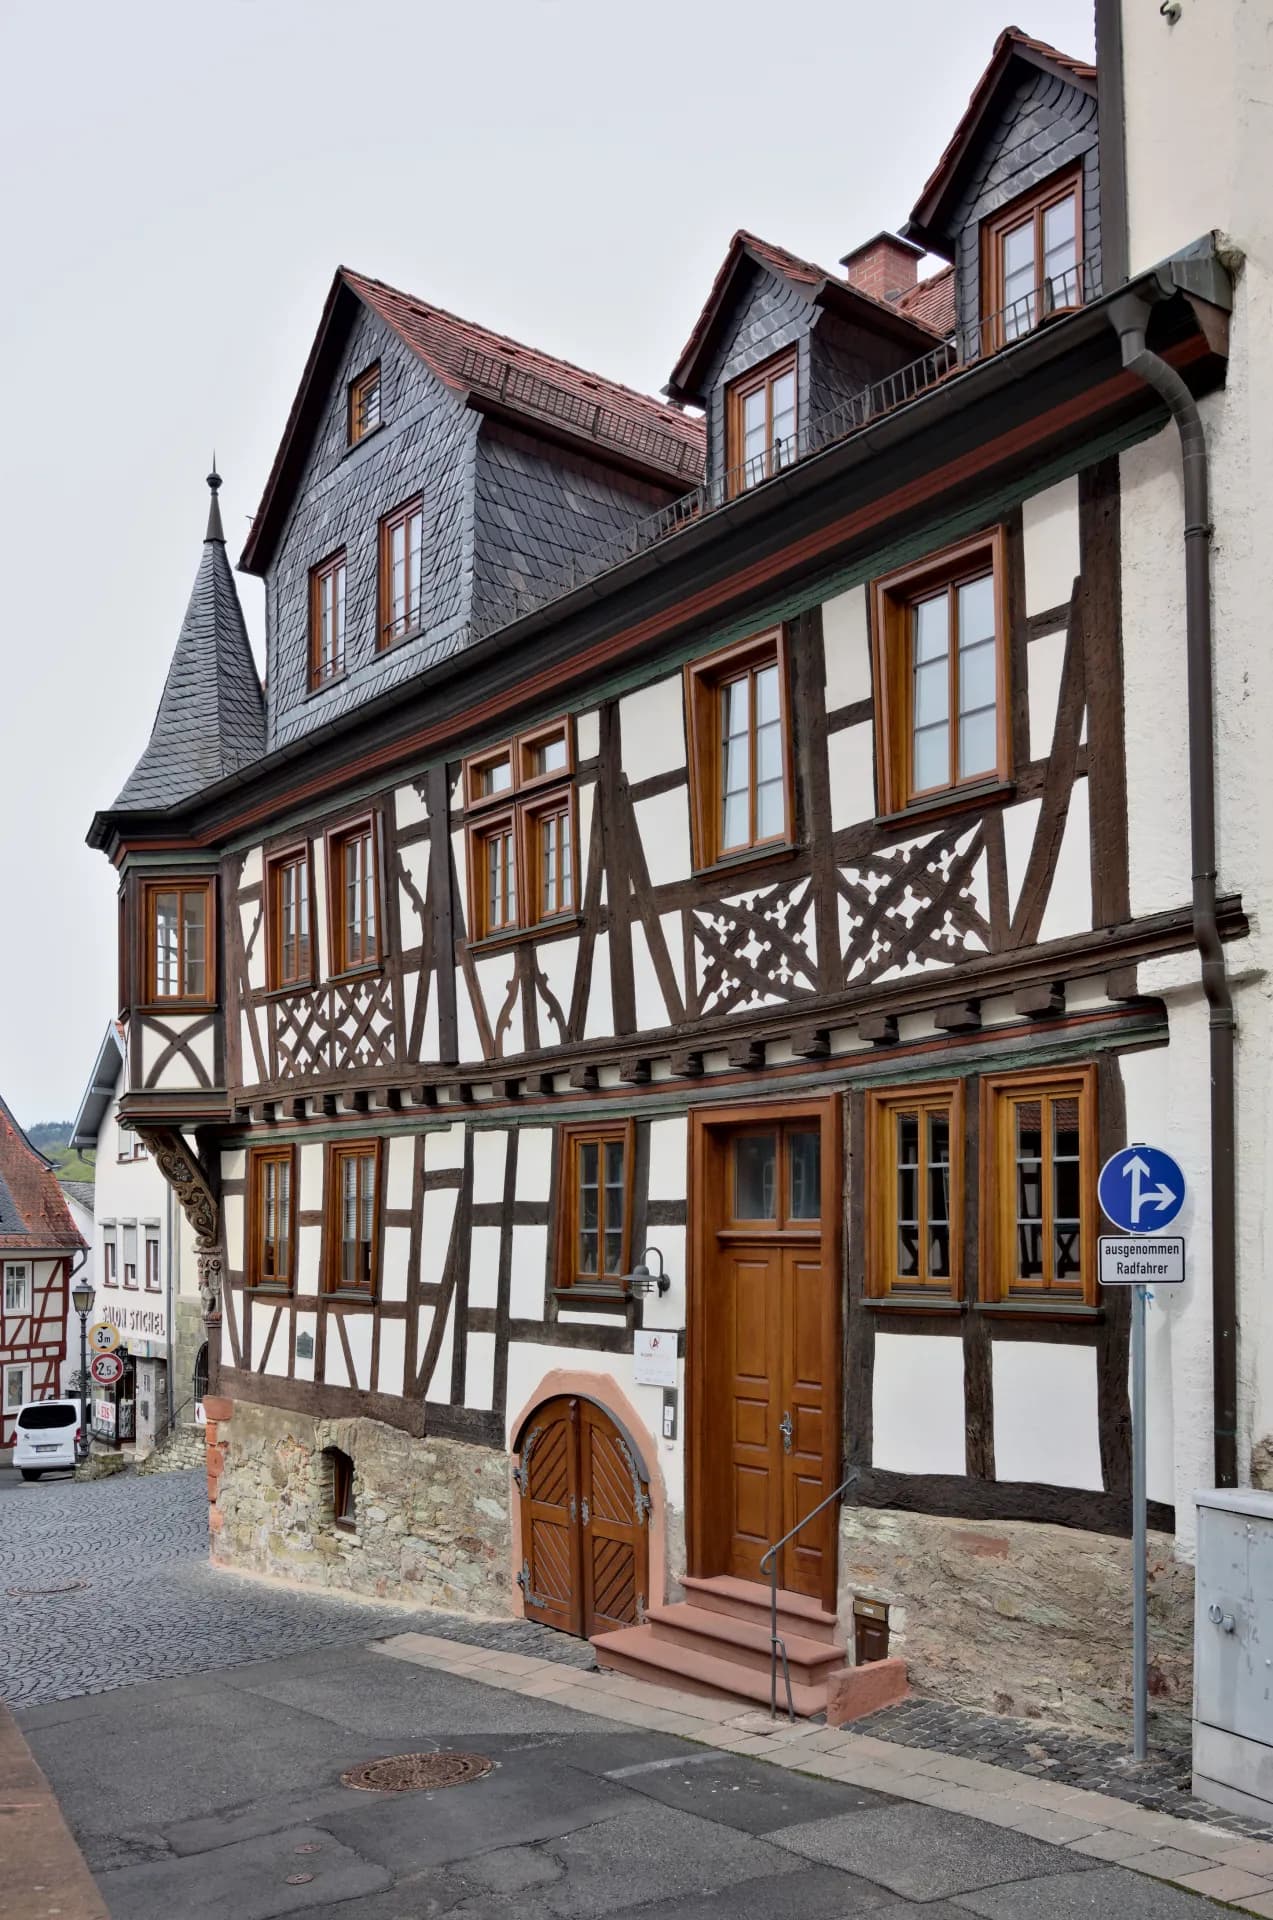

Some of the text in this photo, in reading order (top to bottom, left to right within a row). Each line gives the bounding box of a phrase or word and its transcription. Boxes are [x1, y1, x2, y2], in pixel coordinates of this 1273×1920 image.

[1105, 1245, 1179, 1258] ausgenommen
[1116, 1262, 1168, 1275] Radfahrer
[102, 1305, 166, 1336] SALON STICHEL
